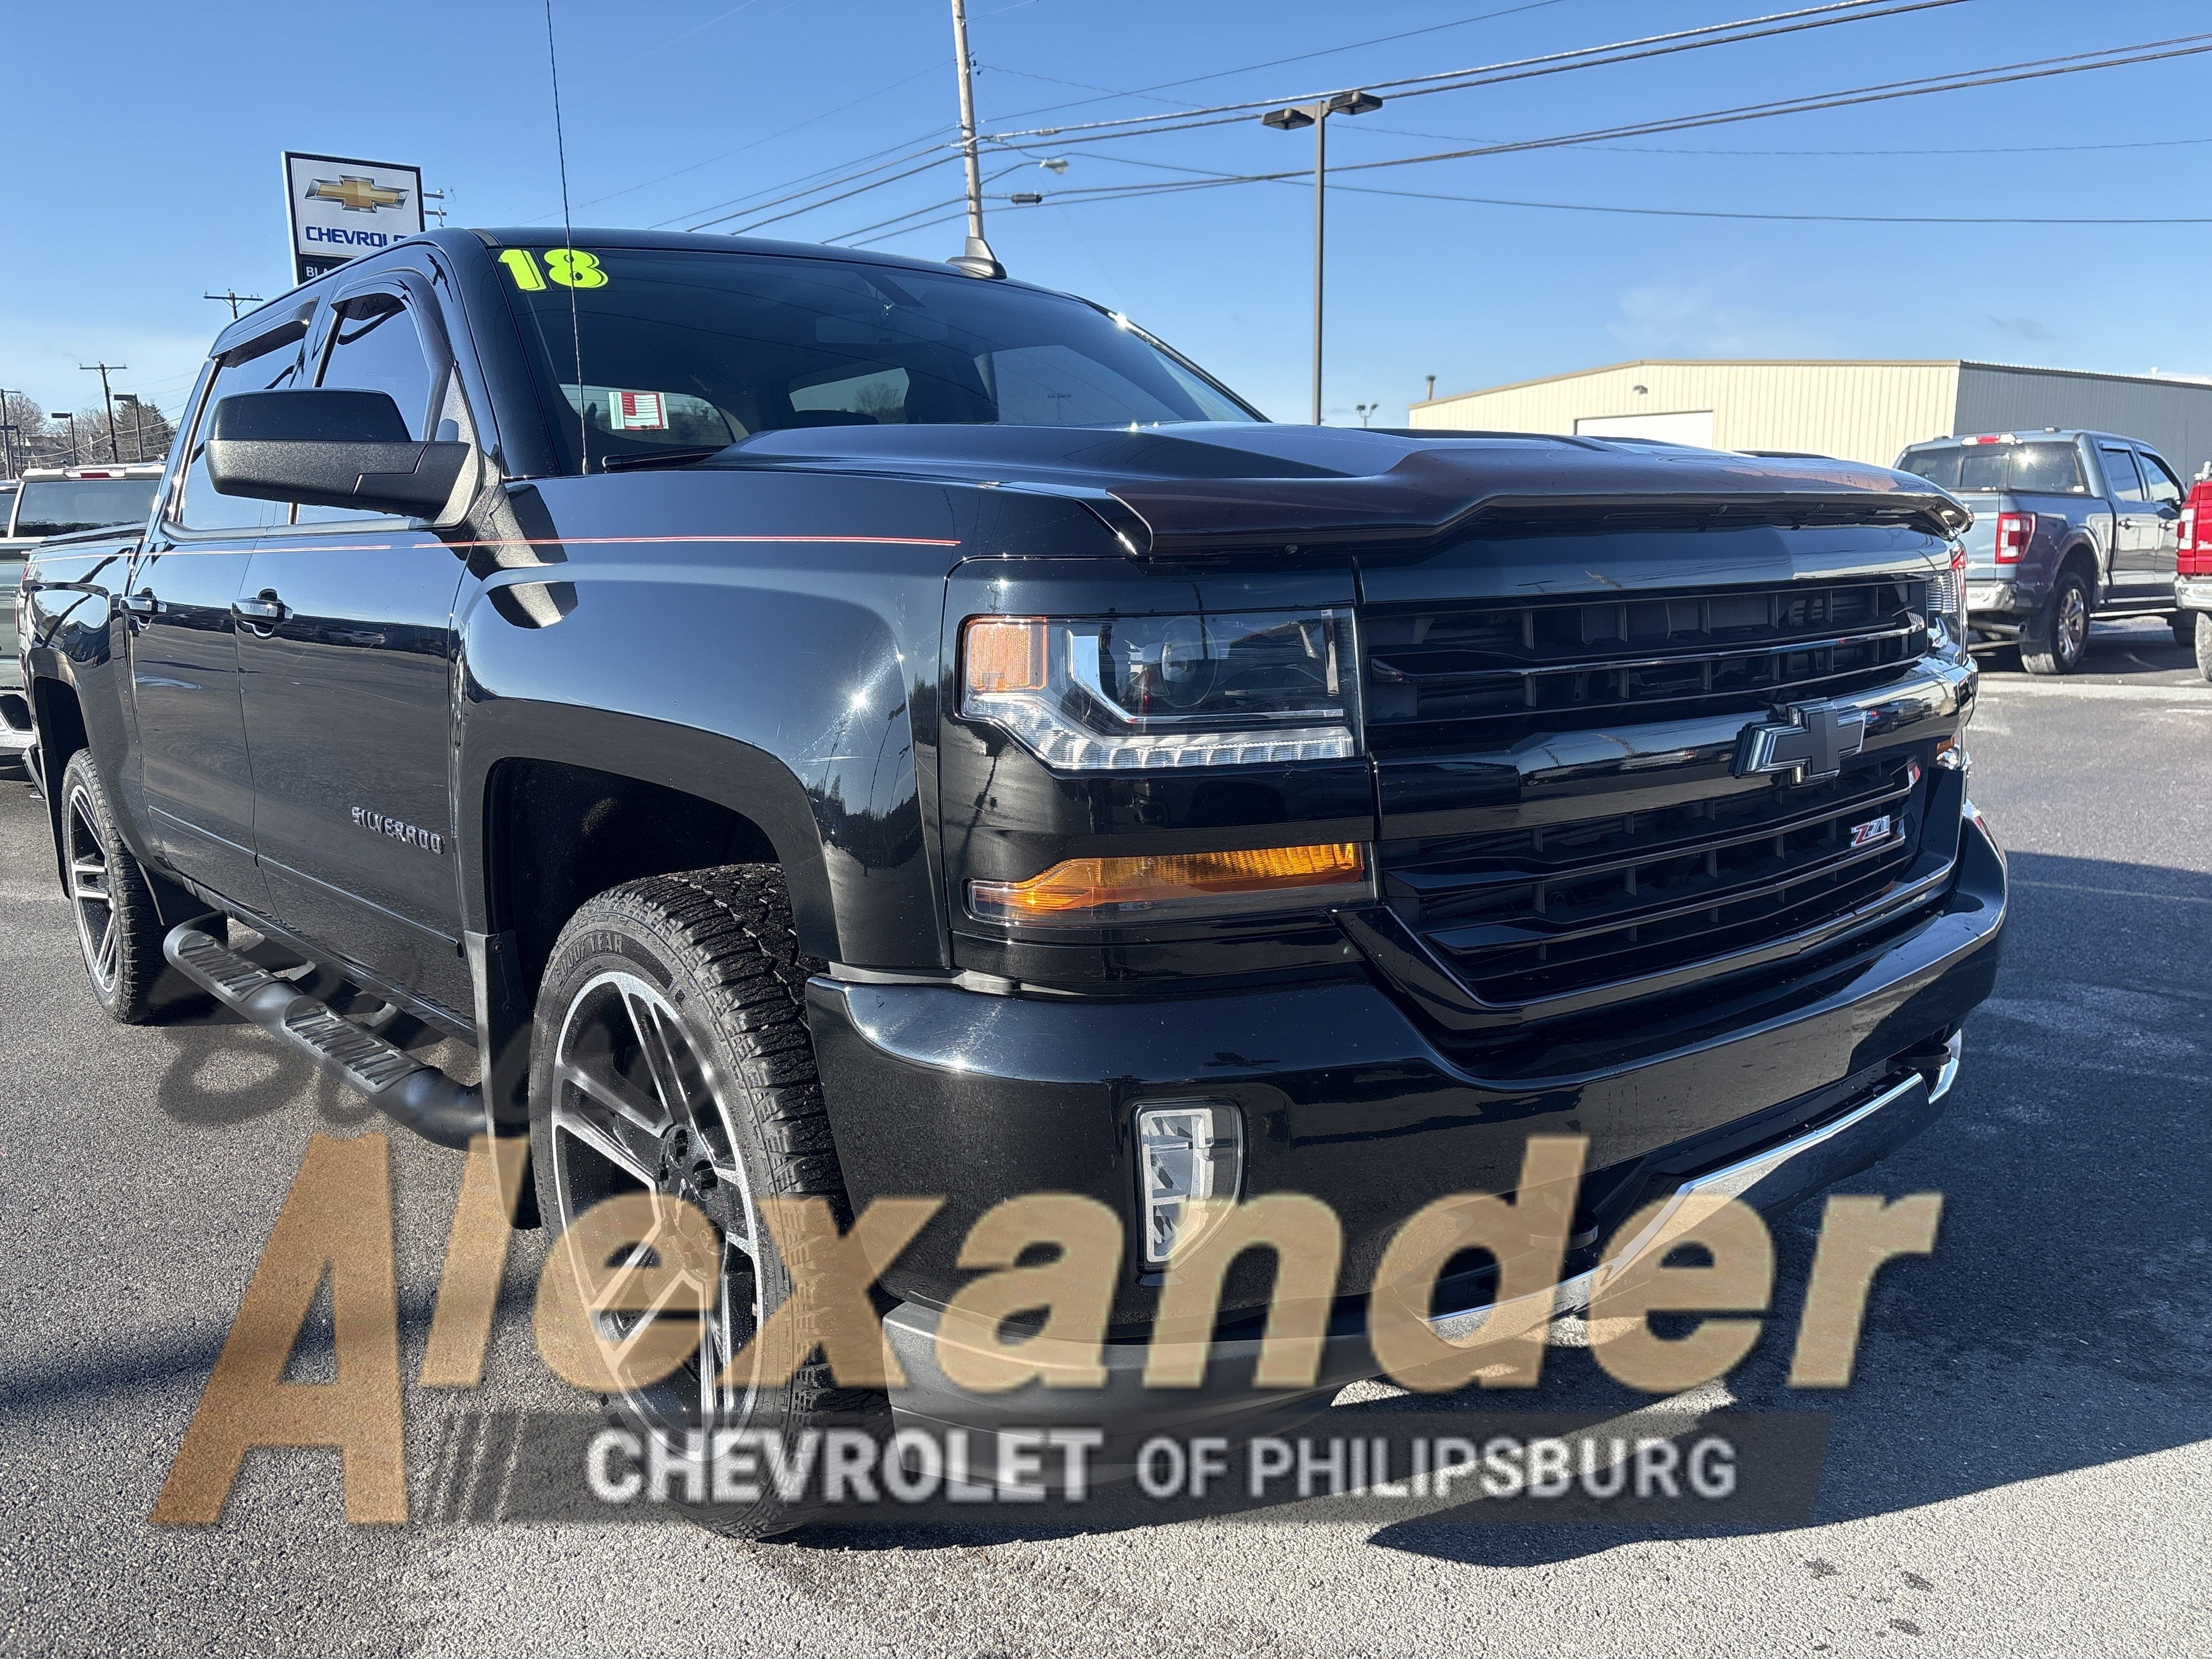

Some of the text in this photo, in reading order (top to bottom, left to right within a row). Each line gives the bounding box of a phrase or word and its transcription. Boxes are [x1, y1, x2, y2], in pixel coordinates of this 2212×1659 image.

[497, 249, 609, 291] 18
[351, 806, 445, 855] SILVERADO
[1850, 815, 1890, 848] Z71
